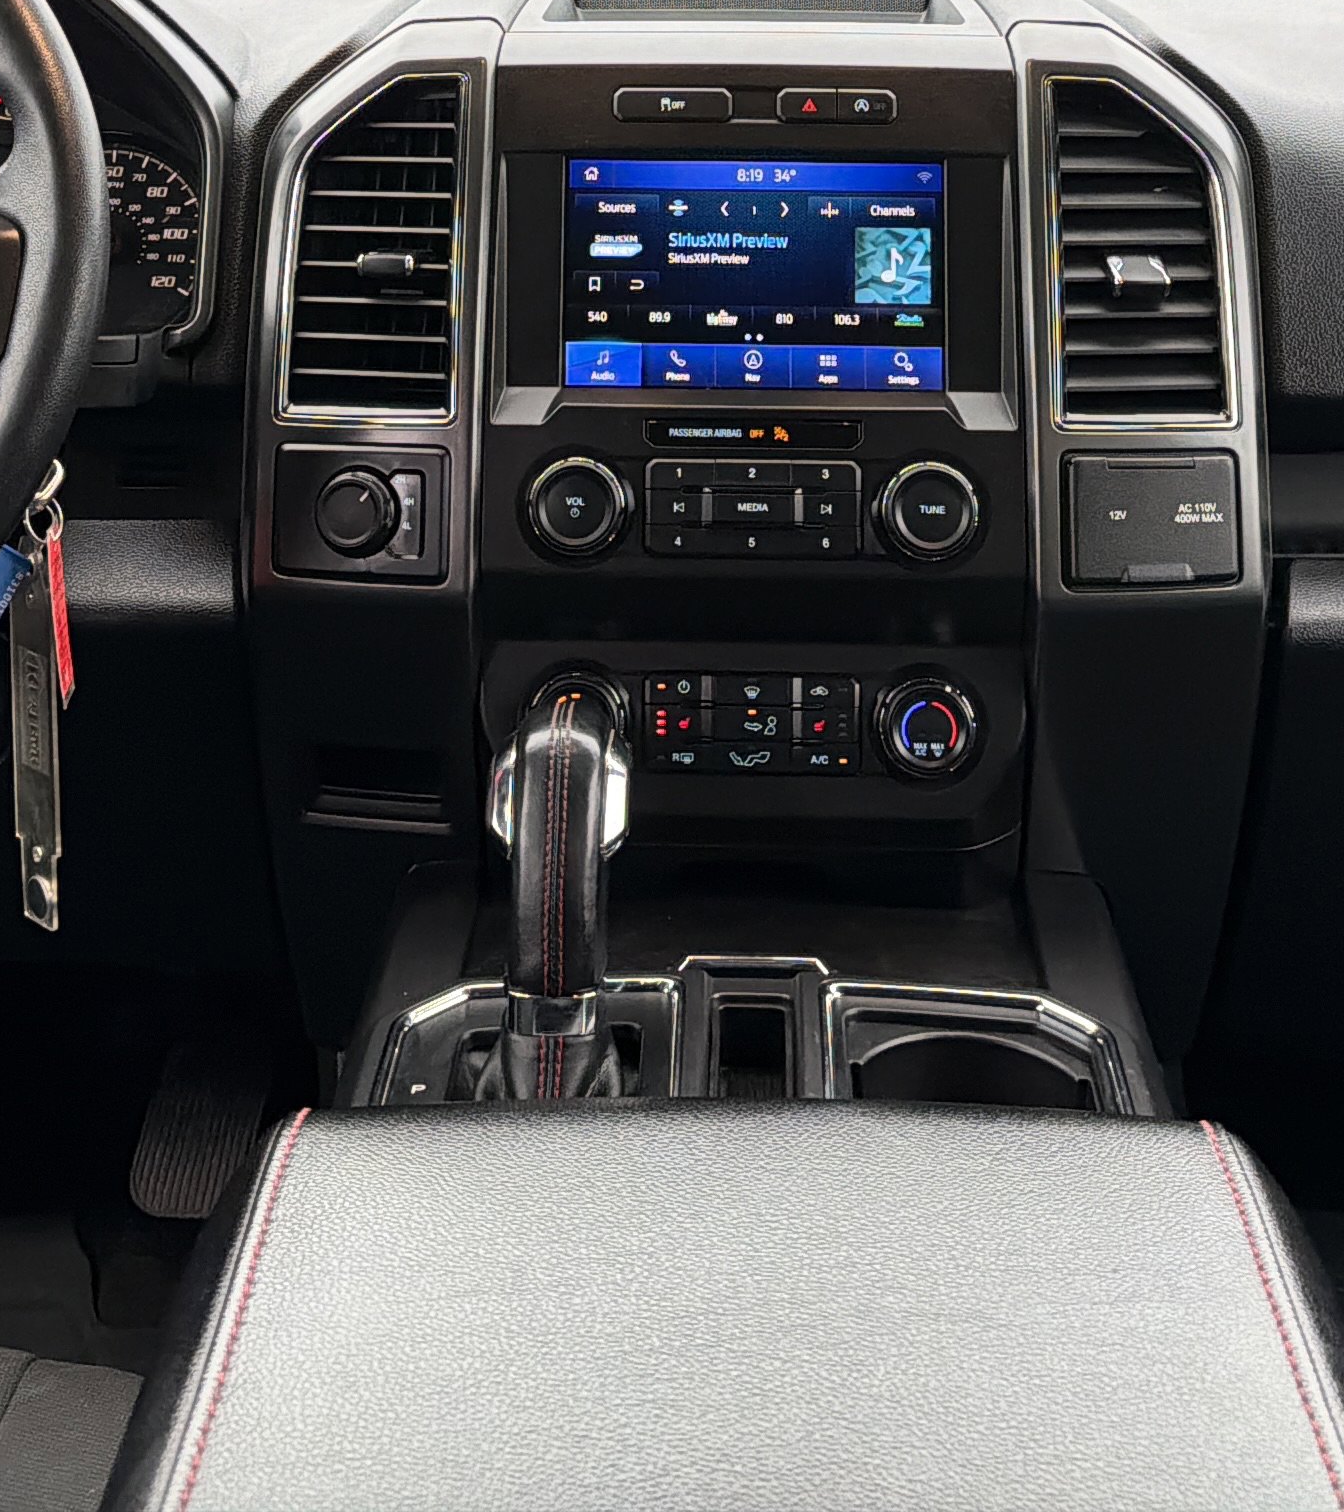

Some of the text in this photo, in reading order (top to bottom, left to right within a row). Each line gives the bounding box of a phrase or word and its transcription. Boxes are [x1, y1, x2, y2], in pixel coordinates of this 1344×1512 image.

[672, 100, 686, 110] OFF
[132, 173, 147, 182] 70
[736, 169, 797, 183] 8:19 34°
[146, 186, 168, 198] 80
[165, 206, 181, 215] 90
[598, 201, 637, 214] Sources
[869, 205, 916, 217] Channels
[162, 228, 188, 240] 100
[668, 232, 789, 249] SiriusXM Preview
[167, 254, 186, 263] 110
[668, 252, 750, 264] SiriusXM Preview
[150, 276, 176, 288] 120
[587, 311, 608, 323] 540
[648, 311, 671, 323] 89.9
[775, 313, 794, 325] 810
[834, 314, 861, 326] 106.3
[590, 371, 616, 381] Audio
[665, 372, 691, 382] Phone
[744, 373, 761, 382] Nav
[818, 374, 839, 385] Apps
[887, 375, 920, 386] Settings
[669, 427, 765, 438] PASSENGER AIRBAG OFF
[676, 467, 682, 478] 1
[748, 468, 756, 478] 2
[821, 469, 830, 479] 3
[403, 497, 415, 507] 4H
[565, 496, 586, 506] VOL
[737, 503, 769, 512] MEDIA
[919, 504, 946, 515] TUNE
[1178, 502, 1217, 513] AC 110V
[1109, 511, 1127, 521] 12V
[1174, 513, 1224, 524] 400W MAX
[401, 521, 412, 530] 4L
[674, 537, 682, 547] 4
[748, 537, 756, 547] 5
[822, 538, 831, 548] 6
[810, 754, 829, 765] A/C
[410, 1084, 427, 1095] P
